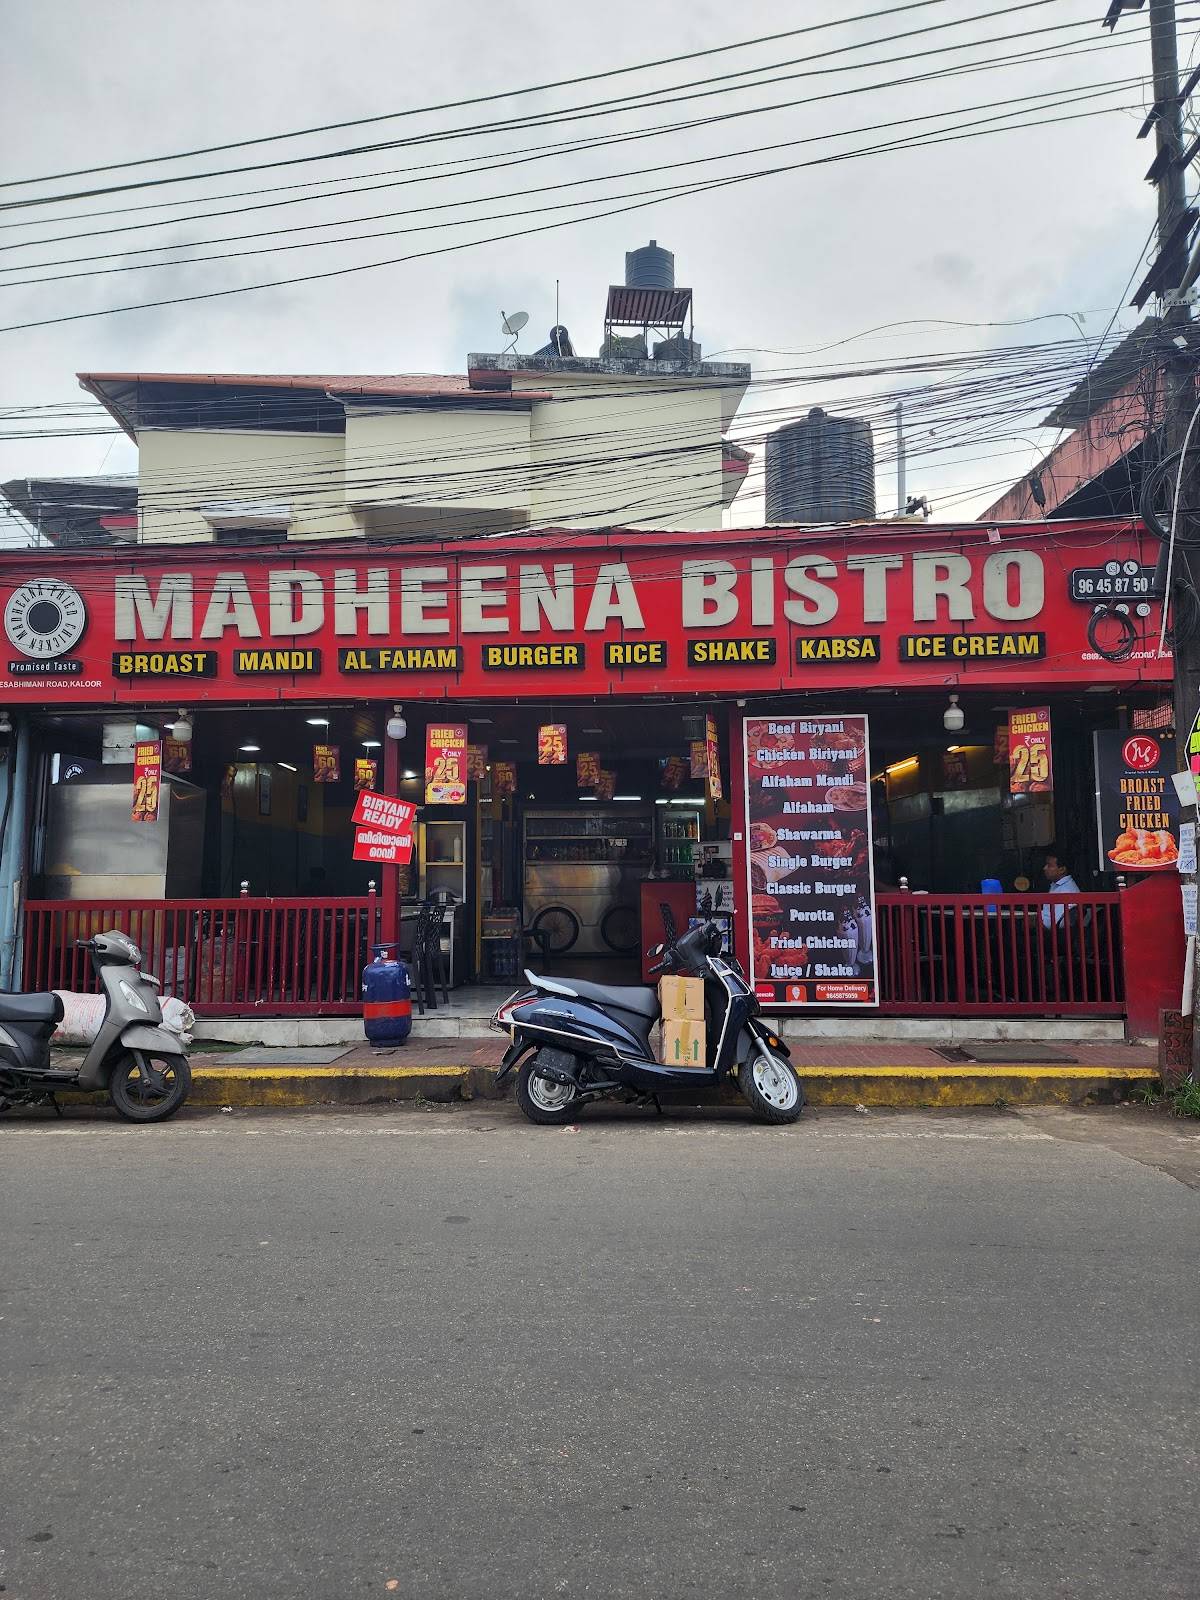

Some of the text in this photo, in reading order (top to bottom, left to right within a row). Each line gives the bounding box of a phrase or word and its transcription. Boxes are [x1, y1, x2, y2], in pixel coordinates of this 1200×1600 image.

[1078, 579, 1094, 594] 96
[1096, 578, 1112, 593] 45
[1115, 578, 1130, 592] 87
[1133, 577, 1149, 592] 50
[115, 550, 1045, 641] MADHEENA BISTRO
[609, 641, 662, 664] RICE
[693, 640, 770, 662] SHAKE
[801, 638, 876, 659] KABSA
[907, 635, 1039, 657] ICE CREAM
[119, 653, 207, 674] BROAST
[239, 651, 313, 671] MANDI
[344, 649, 457, 669] AL FAHAM
[488, 645, 579, 666] BURGER
[10, 662, 77, 672] Promised Taste
[1011, 712, 1038, 725] FRIED
[431, 729, 455, 739] FRIED
[768, 721, 844, 736] Beef Biryani
[1011, 722, 1049, 735] CHICKEN
[137, 746, 154, 757] FRIED
[430, 738, 465, 748] CHICKEN
[542, 736, 564, 753] 25
[756, 748, 806, 762] Chicken
[1009, 743, 1049, 783] 25
[433, 757, 459, 781] 25
[761, 774, 854, 788] Alfaham Mandi
[1119, 777, 1165, 794] BROAST
[135, 775, 158, 812] 25
[362, 794, 411, 820] BIRYANI
[783, 801, 835, 814] Alfaham
[1126, 795, 1161, 811] FRIED
[362, 808, 404, 830] READY
[1119, 812, 1170, 829] CHICKEN
[777, 828, 842, 841] Shawarma
[768, 854, 852, 870] Single Burger
[766, 881, 856, 896] Classic Burger
[790, 908, 835, 922] Porotta
[771, 935, 856, 949] Fried Chicken
[771, 963, 803, 977] Juice
[815, 963, 854, 977] Shake
